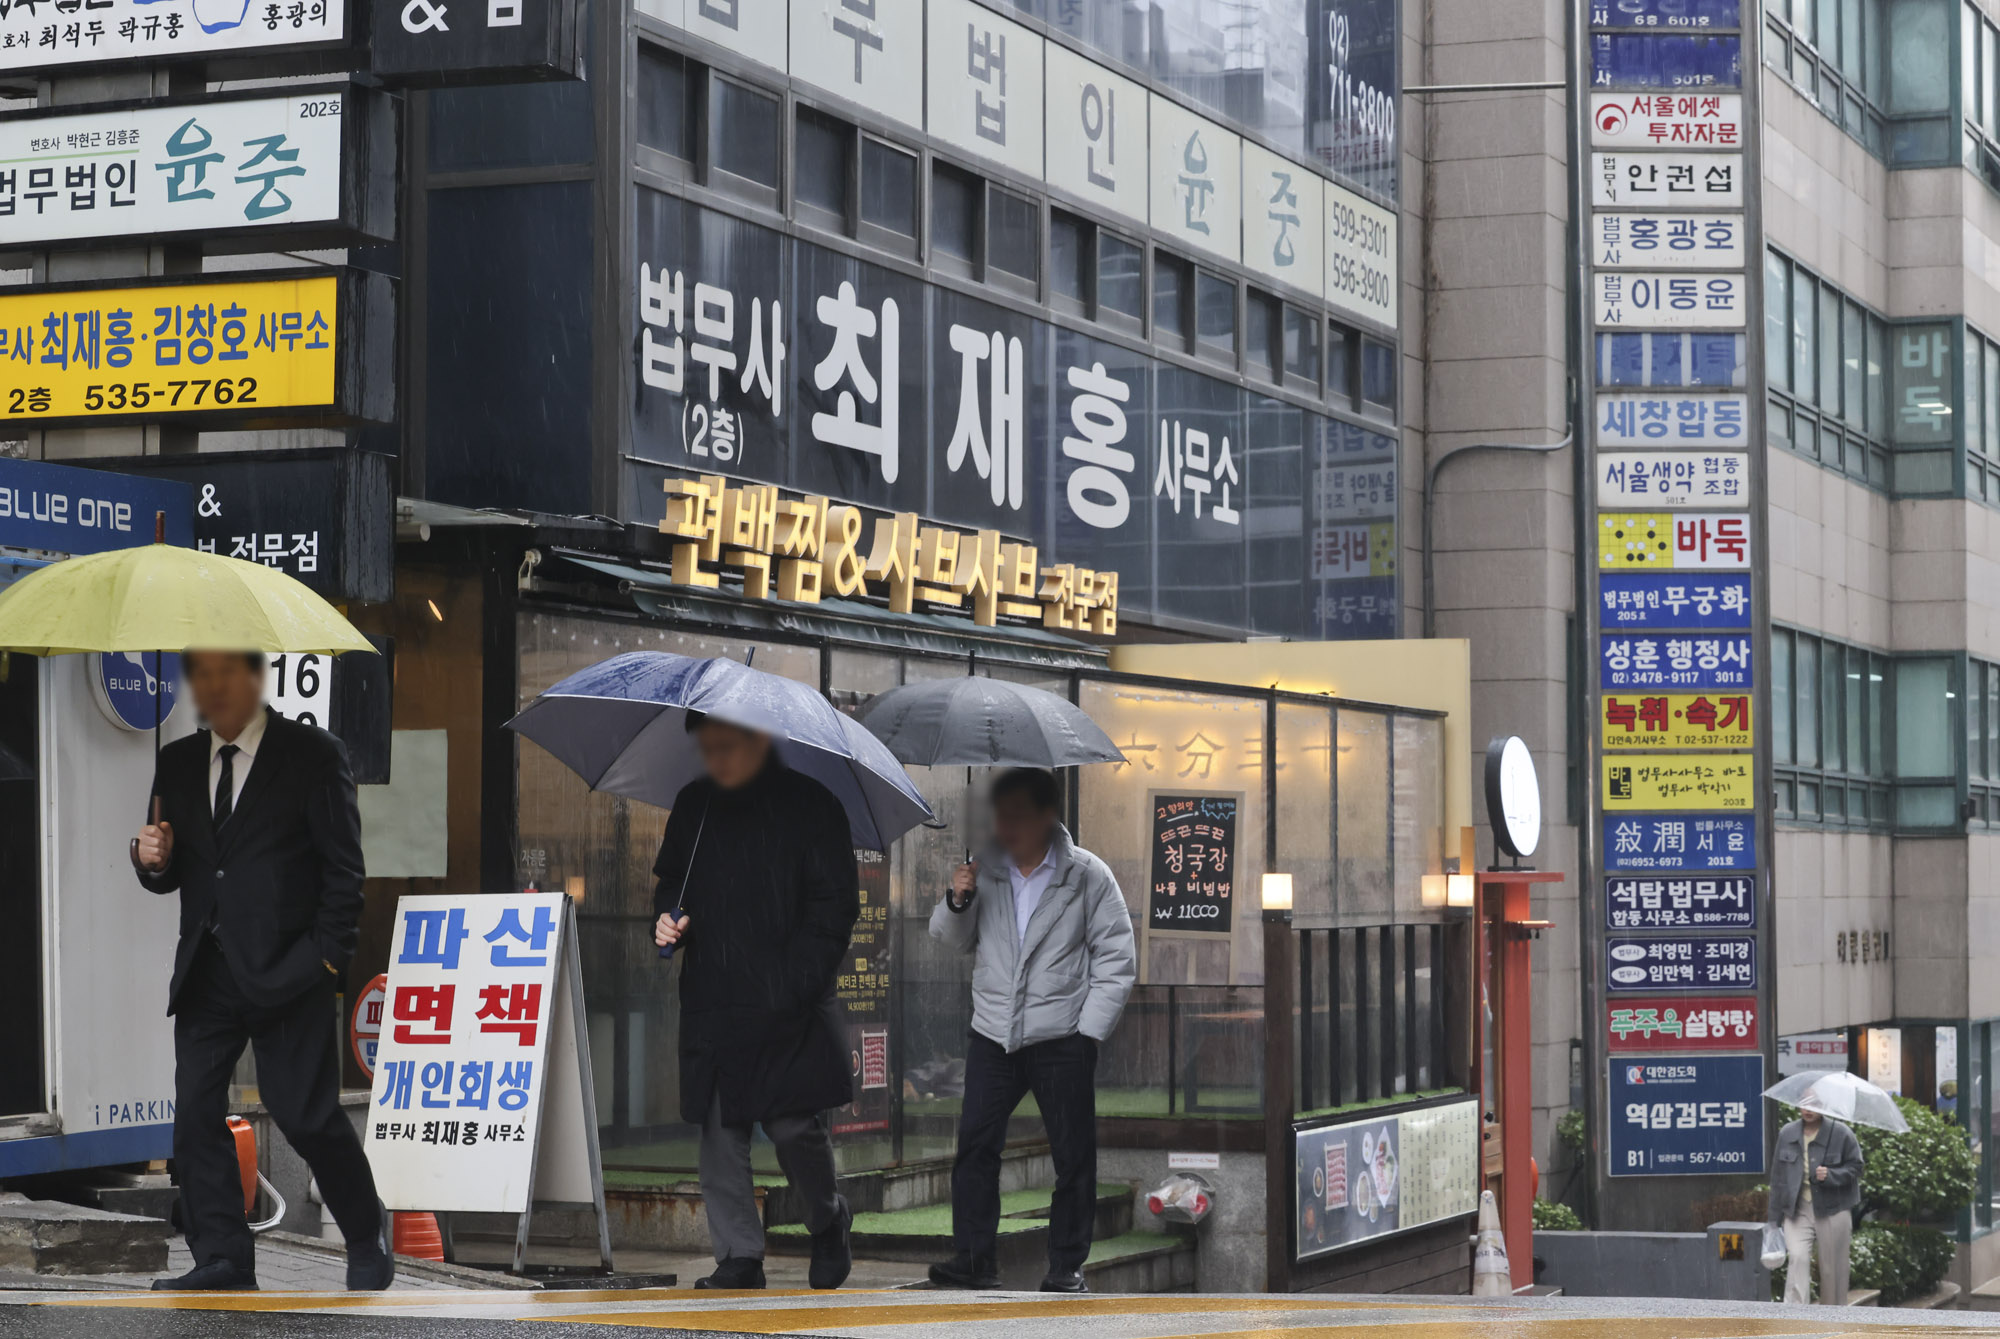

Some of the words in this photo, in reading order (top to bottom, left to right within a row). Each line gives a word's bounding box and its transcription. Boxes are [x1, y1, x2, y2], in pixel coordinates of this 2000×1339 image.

[262, 0, 327, 30] 홍광의
[1668, 16, 1710, 25] 601호
[39, 20, 105, 50] 최석두
[118, 12, 184, 41] 곽규홍
[300, 100, 342, 118] 202호
[1329, 64, 1394, 143] 711-3800
[1631, 96, 1720, 118] 서울에셋
[30, 137, 60, 152] 변호사
[67, 132, 101, 149] 박현근
[105, 129, 140, 147] 김흥준
[1648, 122, 1738, 144] 투자자문
[1628, 164, 1732, 192] 안권섭
[1333, 201, 1387, 259] 599-5301
[1602, 217, 1622, 264] 법무사
[1629, 218, 1735, 250] 홍광호
[1333, 253, 1389, 309] 596-3900
[1631, 278, 1735, 310] 이동윤
[1603, 275, 1623, 323] 법무사
[254, 310, 329, 352] 사무소
[9, 386, 52, 414] 2층
[84, 377, 258, 411] 535-7762
[641, 262, 785, 417] 법무사
[811, 281, 1135, 529] 최재홍
[1154, 419, 1240, 526] 사무소
[682, 400, 744, 465] (2층)
[1602, 400, 1742, 438] 세창합동
[1606, 461, 1695, 493] 서울생약
[1703, 457, 1740, 474] 협동
[198, 483, 222, 517] &
[1703, 479, 1740, 495] 조합
[1677, 518, 1747, 562] 바둑
[1603, 590, 1660, 609] 법무법인
[1662, 584, 1749, 616] 무궁화
[1617, 611, 1647, 621] 205호
[1604, 639, 1660, 670] 성훈
[1666, 639, 1751, 670] 행정사
[1632, 671, 1699, 684] 3478-9117
[1715, 671, 1744, 683] 301호
[1607, 736, 1667, 745] 다연속기사무소
[1684, 735, 1748, 745] 02-537-1222
[1637, 766, 1715, 782] 법무사사무소
[1722, 766, 1747, 777] 바로
[1658, 784, 1693, 798] 법무사
[1723, 798, 1746, 806] 203호
[1695, 821, 1744, 831] 법률사무소
[1165, 844, 1228, 873] 청국장
[1707, 856, 1735, 866] 201호
[1156, 882, 1177, 896] 나물
[1187, 881, 1230, 898] 비빔밥
[1612, 881, 1665, 909] 석탑
[1668, 880, 1747, 908] 법무사
[1177, 904, 1219, 919] 11000
[1612, 910, 1642, 926] 합동
[1645, 910, 1690, 925] 사무소
[1704, 913, 1750, 922] 586-7788
[398, 907, 556, 969] 파산
[1618, 949, 1640, 957] 법무사
[1648, 943, 1692, 960] 최영민
[1704, 943, 1748, 959] 조미경
[1649, 965, 1693, 981] 임만혁
[1707, 964, 1750, 981] 김세연
[393, 984, 542, 1046] 면책
[1610, 1008, 1682, 1040] 푸주옥
[379, 1061, 533, 1111] 개인회생
[1647, 1066, 1696, 1078] 대한검도회
[1626, 1102, 1747, 1129] 역삼검도관
[375, 1123, 416, 1140] 법무사
[421, 1121, 479, 1145] 최재홍
[484, 1124, 525, 1141] 사무소
[1628, 1150, 1644, 1167] B1
